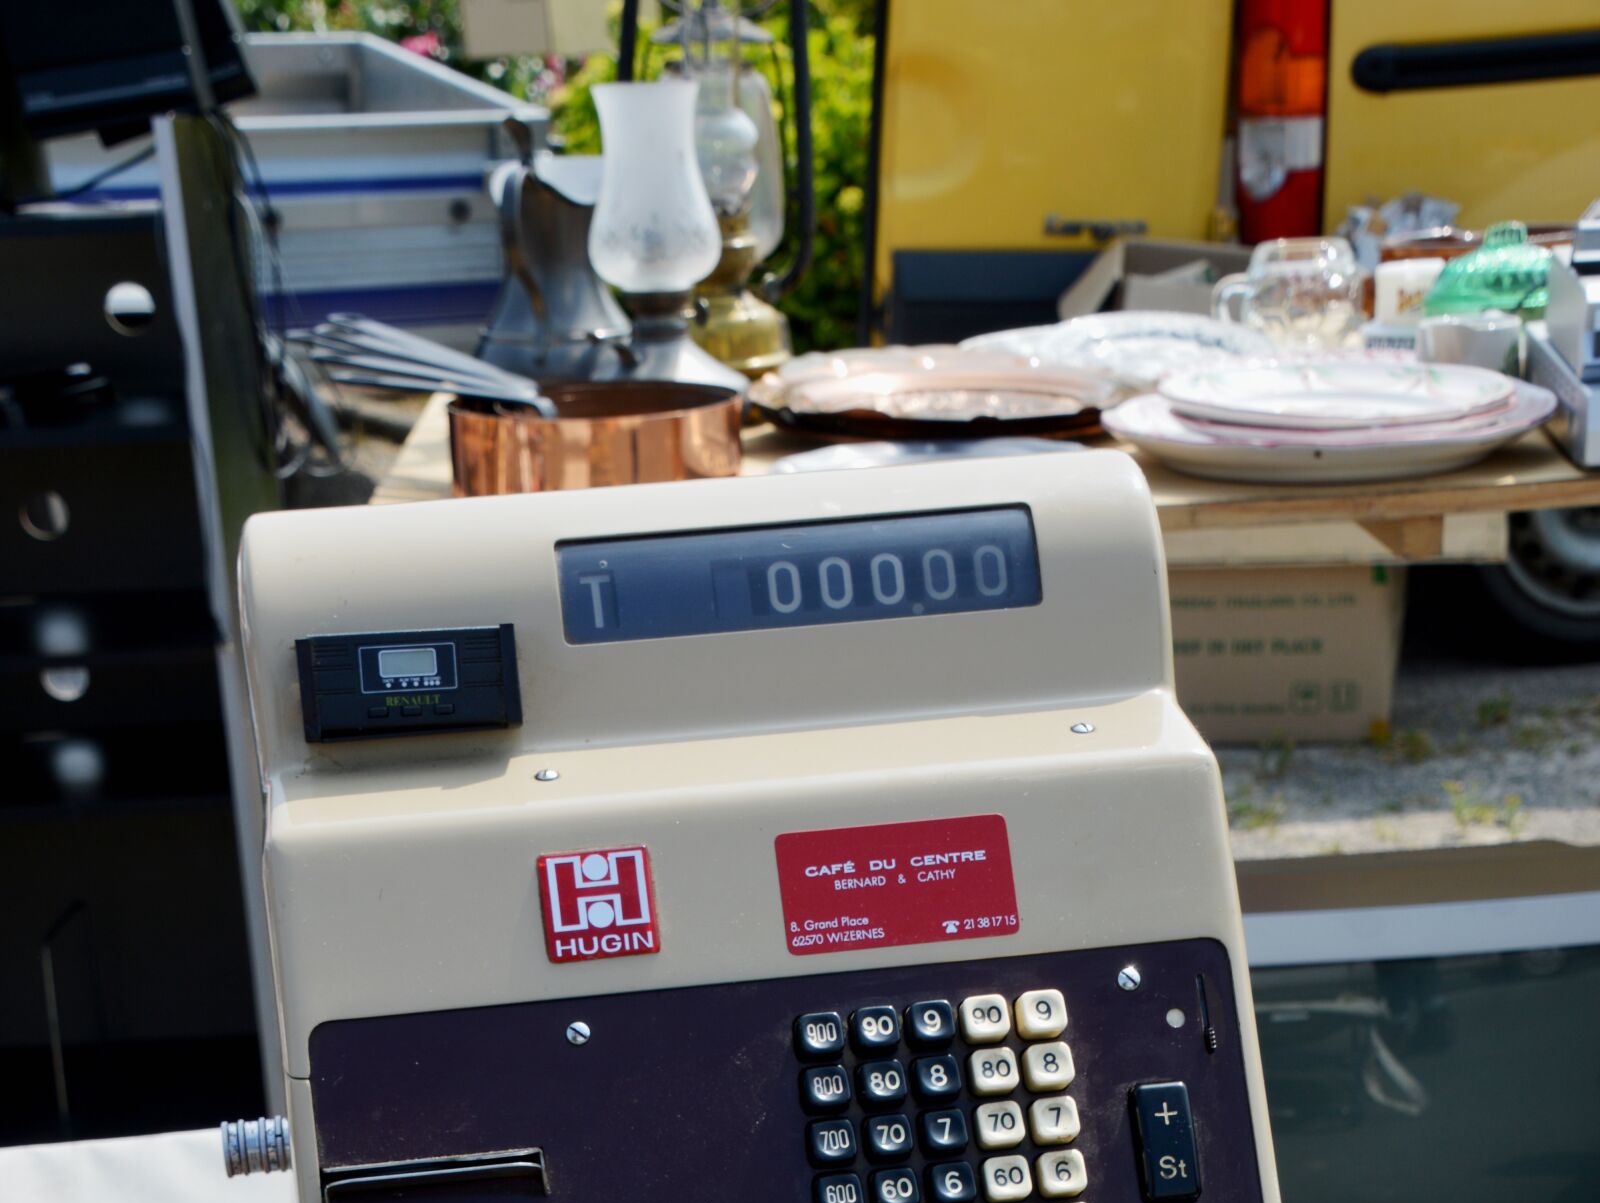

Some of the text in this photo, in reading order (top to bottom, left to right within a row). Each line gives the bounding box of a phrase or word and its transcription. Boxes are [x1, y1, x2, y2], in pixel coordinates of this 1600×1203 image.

[579, 574, 610, 629] T
[385, 694, 441, 708] RENAULT
[805, 850, 986, 877] CAFÉ DU CENTRE
[834, 868, 956, 890] BERNARD & CATHY
[804, 918, 838, 931] Grand
[841, 916, 869, 927] Place
[555, 931, 654, 957] HUGIN
[792, 928, 885, 947] 62570 WIZERNES
[923, 1009, 942, 1031] 9
[972, 1006, 1002, 1025] 90
[1035, 1000, 1051, 1021] 9
[806, 1022, 837, 1042] 900
[861, 1015, 894, 1037] 90
[981, 1058, 1011, 1079] 80
[1043, 1052, 1060, 1073] 8
[813, 1075, 843, 1096] 800
[869, 1070, 901, 1091] 80
[929, 1064, 948, 1086] 8
[987, 1112, 1016, 1132] 70
[1048, 1107, 1062, 1127] 7
[818, 1128, 850, 1149] 700
[876, 1123, 906, 1145] 70
[936, 1117, 951, 1141] 7
[993, 1166, 1024, 1186] 60
[1054, 1161, 1072, 1182] 6
[1159, 1155, 1188, 1180] St
[880, 1177, 913, 1199] 60
[944, 1170, 963, 1194] 6
[825, 1183, 857, 1203] 600
